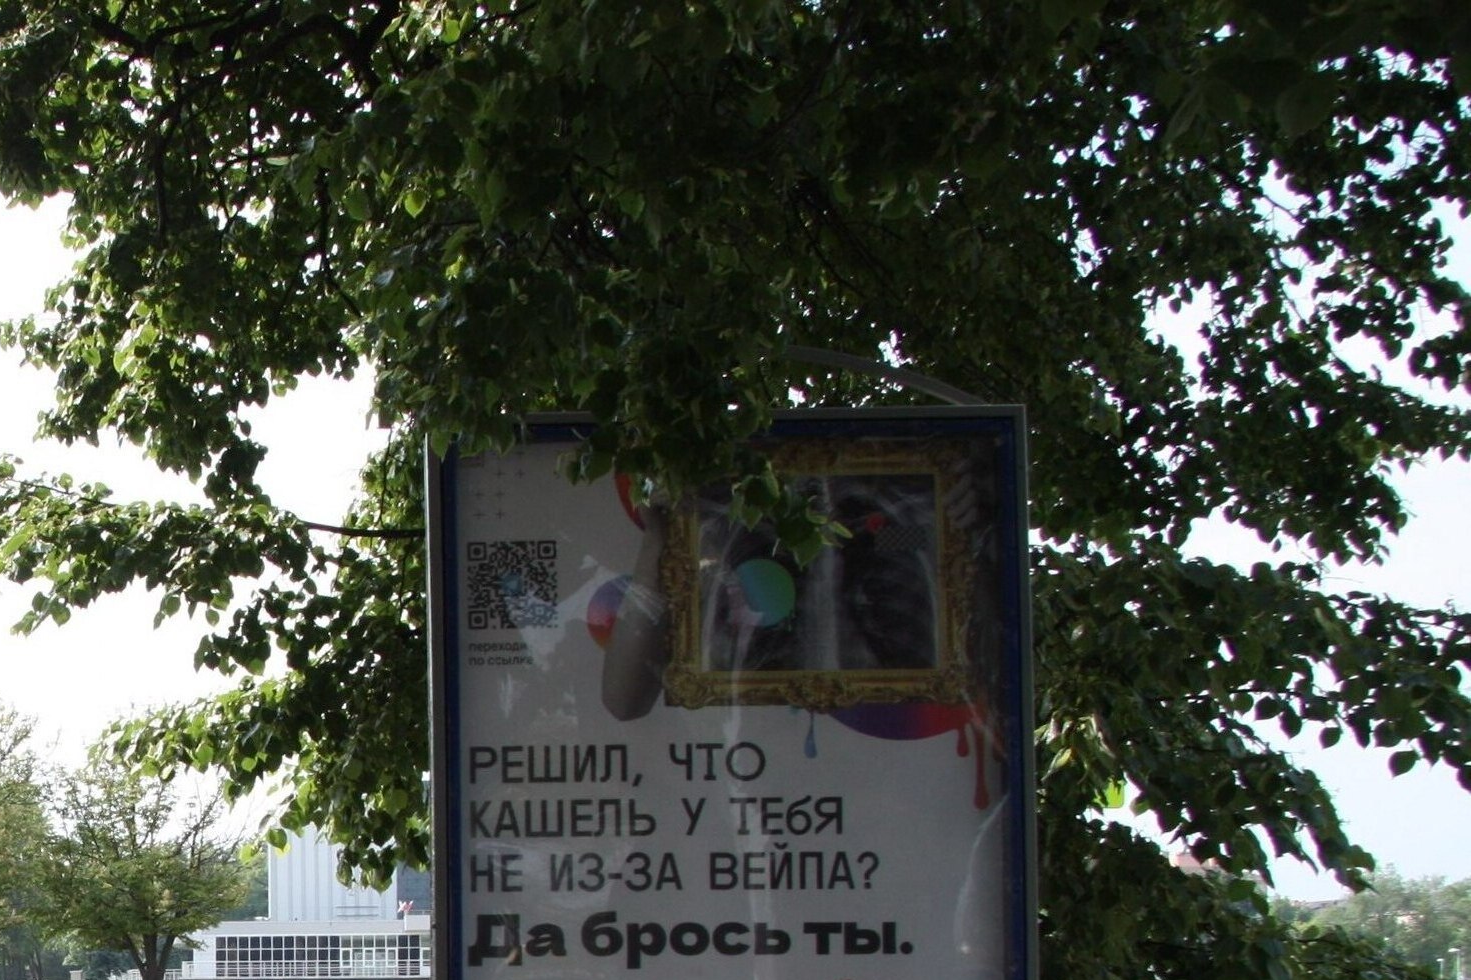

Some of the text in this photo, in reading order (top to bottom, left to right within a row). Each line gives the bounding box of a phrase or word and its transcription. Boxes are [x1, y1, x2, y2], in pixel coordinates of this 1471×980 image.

[468, 657, 484, 666] по
[469, 741, 767, 787] РЕШИЛ, ЧТО
[469, 797, 657, 838] КАШЕЛЬ
[681, 798, 706, 837] У
[470, 843, 880, 893] НЕ ИЗ-ЗА ВЕЙПА?
[468, 910, 913, 969] Да брось ты.
